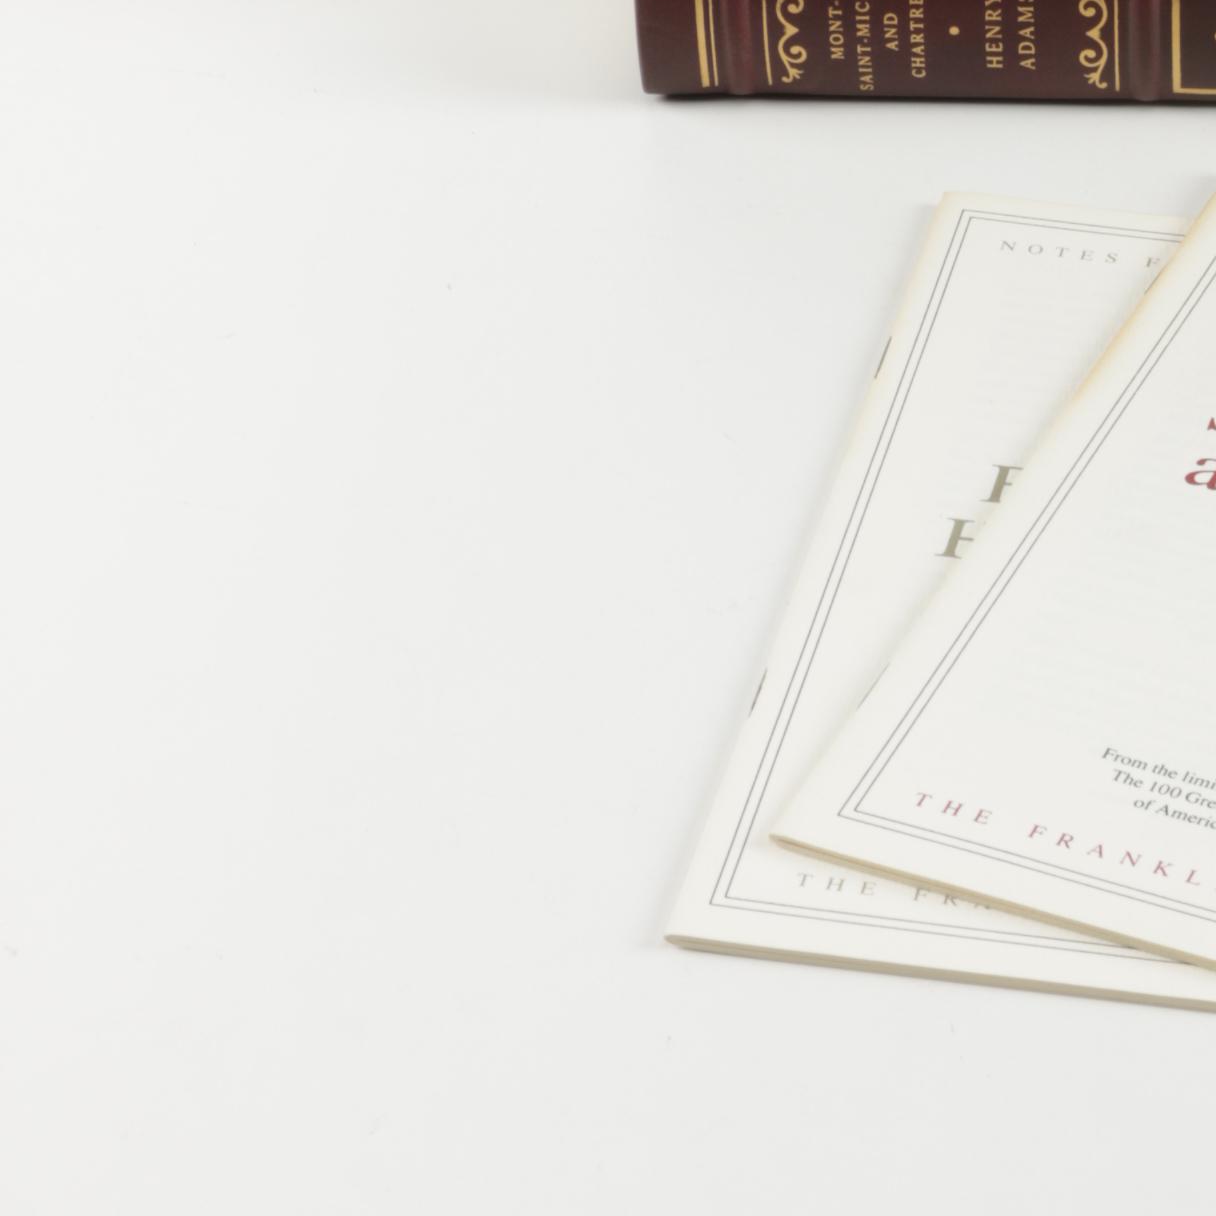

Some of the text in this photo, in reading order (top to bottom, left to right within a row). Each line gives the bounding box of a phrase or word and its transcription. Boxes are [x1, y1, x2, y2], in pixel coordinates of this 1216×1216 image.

[828, 0, 845, 60] MONT-
[883, 12, 899, 52] AND
[1000, 240, 1119, 264] NOTES
[1101, 747, 1149, 771] From
[1151, 764, 1179, 780] the
[1111, 768, 1144, 789] The
[1149, 781, 1183, 799] 100
[915, 792, 993, 826] THE
[1133, 799, 1156, 811] of
[797, 872, 878, 896] THE
